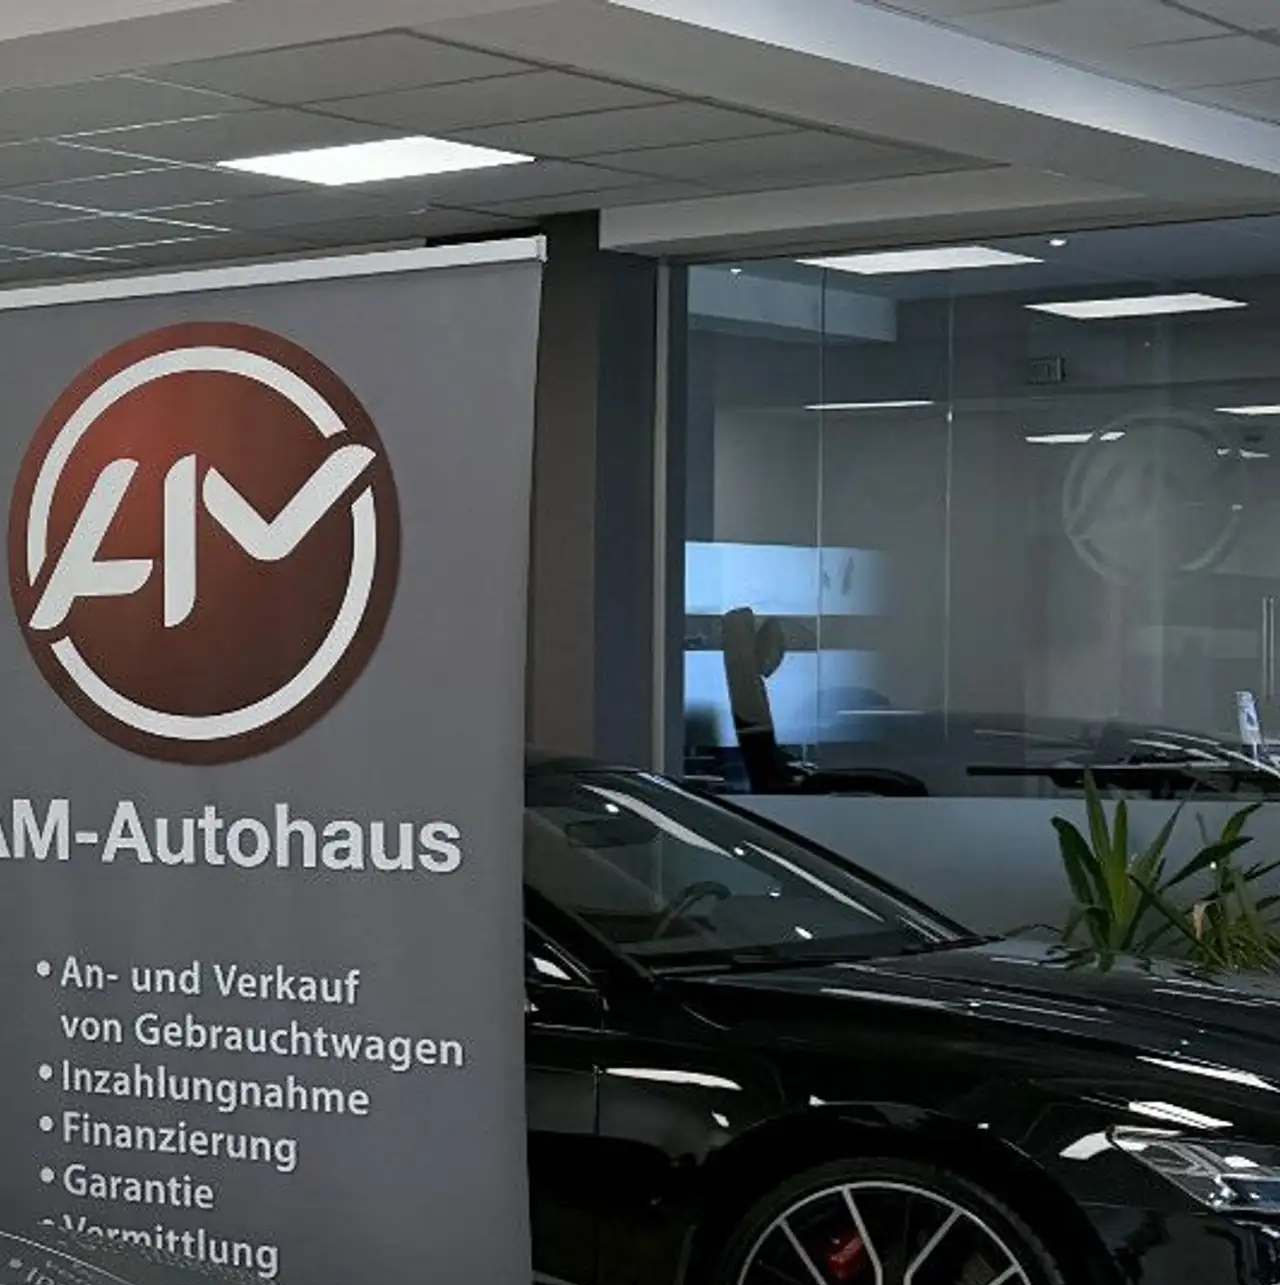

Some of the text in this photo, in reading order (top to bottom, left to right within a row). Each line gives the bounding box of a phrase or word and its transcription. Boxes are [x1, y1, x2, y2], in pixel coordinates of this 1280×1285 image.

[60, 955, 361, 1006] An- und Verkauf
[60, 1012, 463, 1072] von Gebrauchtwagen
[63, 1059, 369, 1115] Inzahlungnahme
[63, 1111, 297, 1172] Finanzierung
[63, 1163, 214, 1209] Garantie
